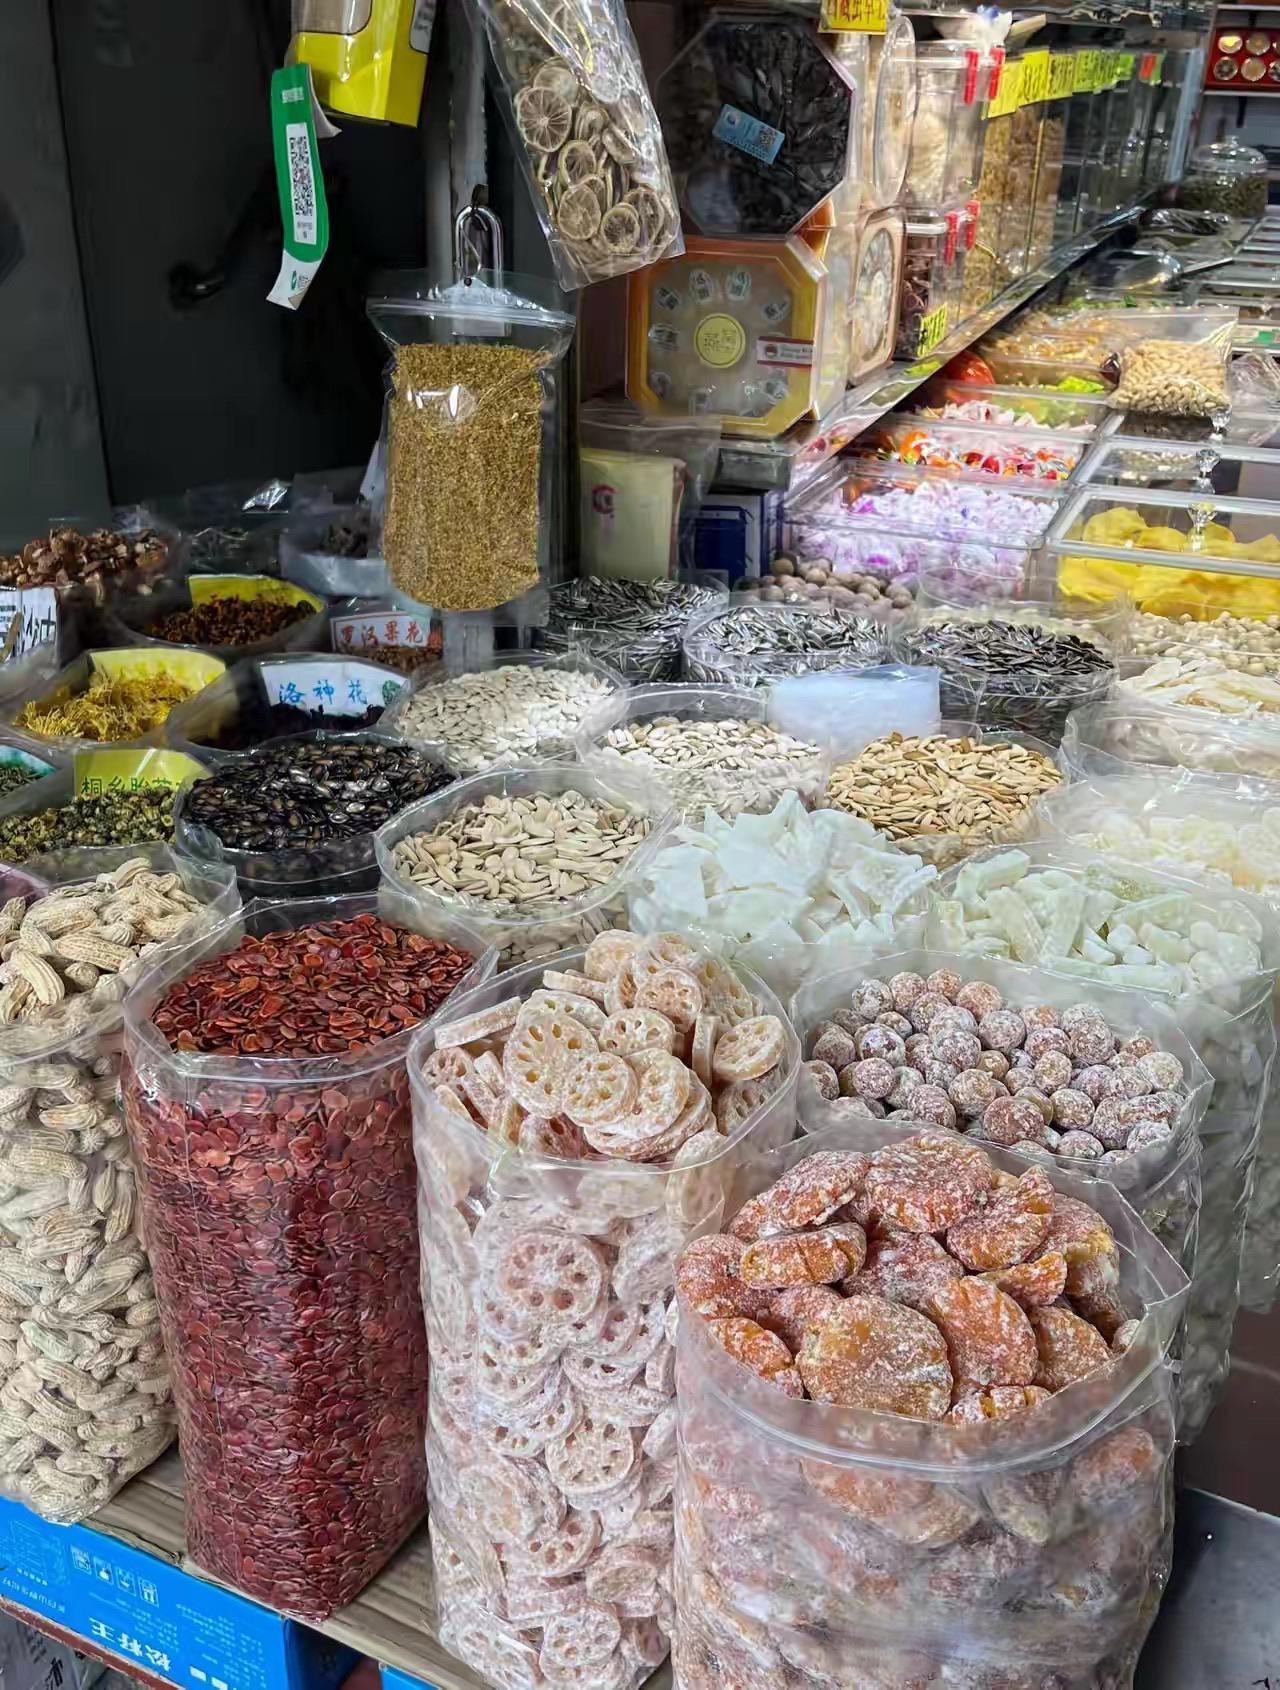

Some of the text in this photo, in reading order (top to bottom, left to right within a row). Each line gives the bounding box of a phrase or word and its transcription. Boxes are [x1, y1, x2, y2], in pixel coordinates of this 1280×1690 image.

[279, 679, 368, 705] 洛神花
[89, 1616, 171, 1672] 松籽王
